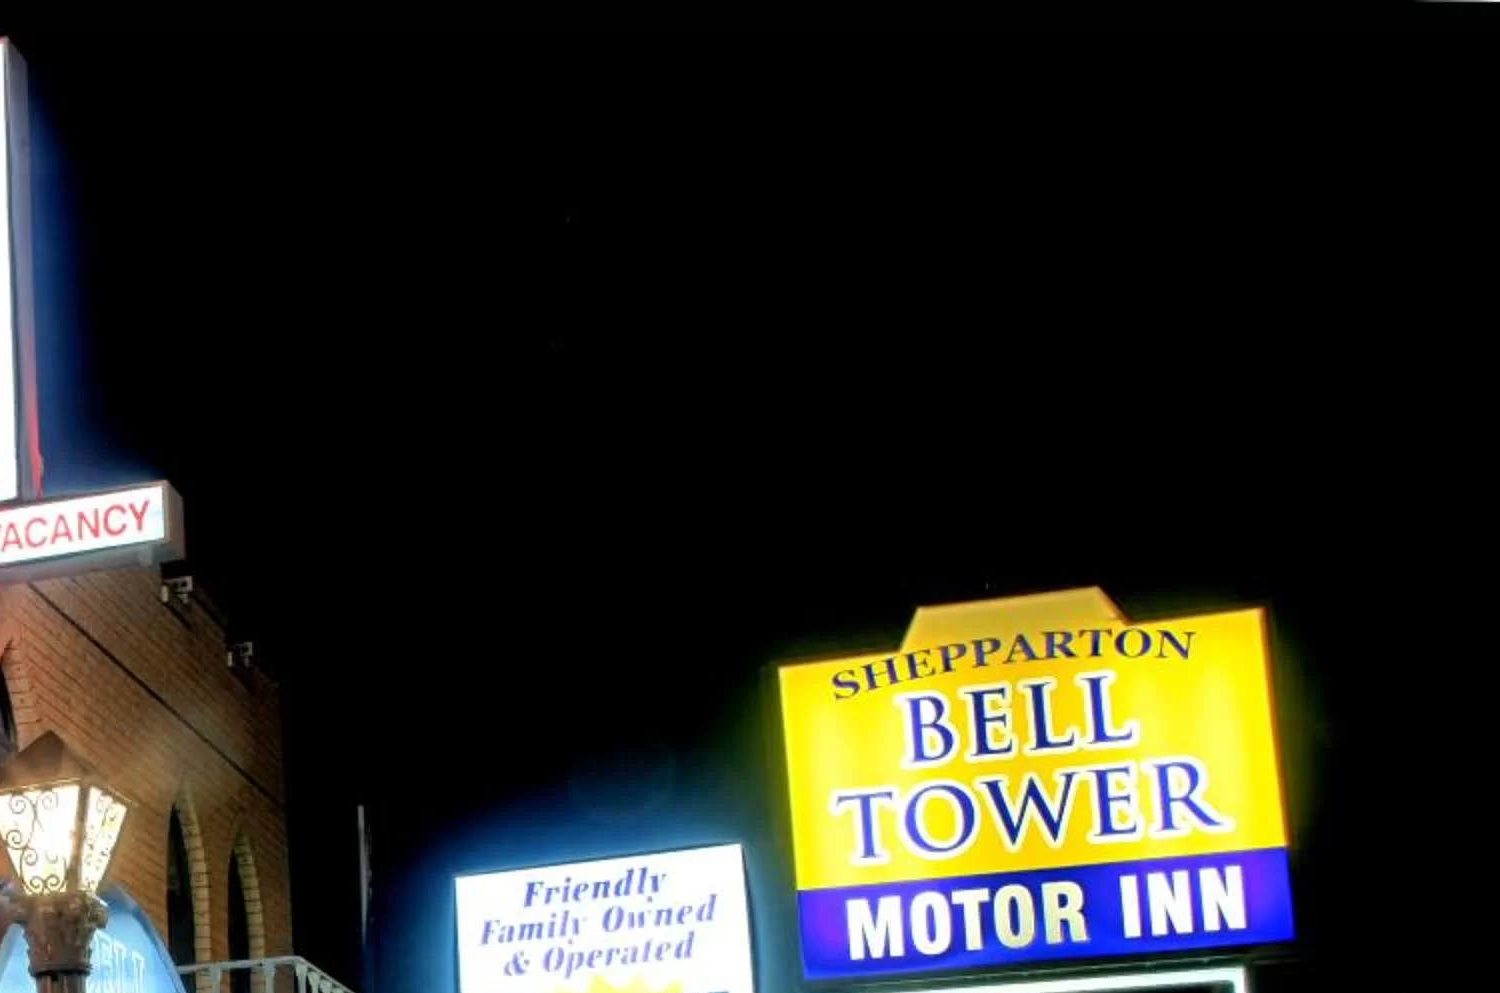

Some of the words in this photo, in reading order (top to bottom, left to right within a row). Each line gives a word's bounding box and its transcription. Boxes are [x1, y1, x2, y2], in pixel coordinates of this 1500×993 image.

[831, 628, 1196, 701] SHEPPARTON
[904, 674, 1134, 764] BELL
[837, 762, 1224, 860] TOWER
[480, 909, 588, 946] Family
[601, 893, 717, 933] Owned
[523, 866, 667, 907] Friendly
[846, 881, 1091, 961] MOTOR
[1119, 865, 1248, 939] INN
[503, 950, 531, 976] &
[542, 930, 695, 980] Operated
